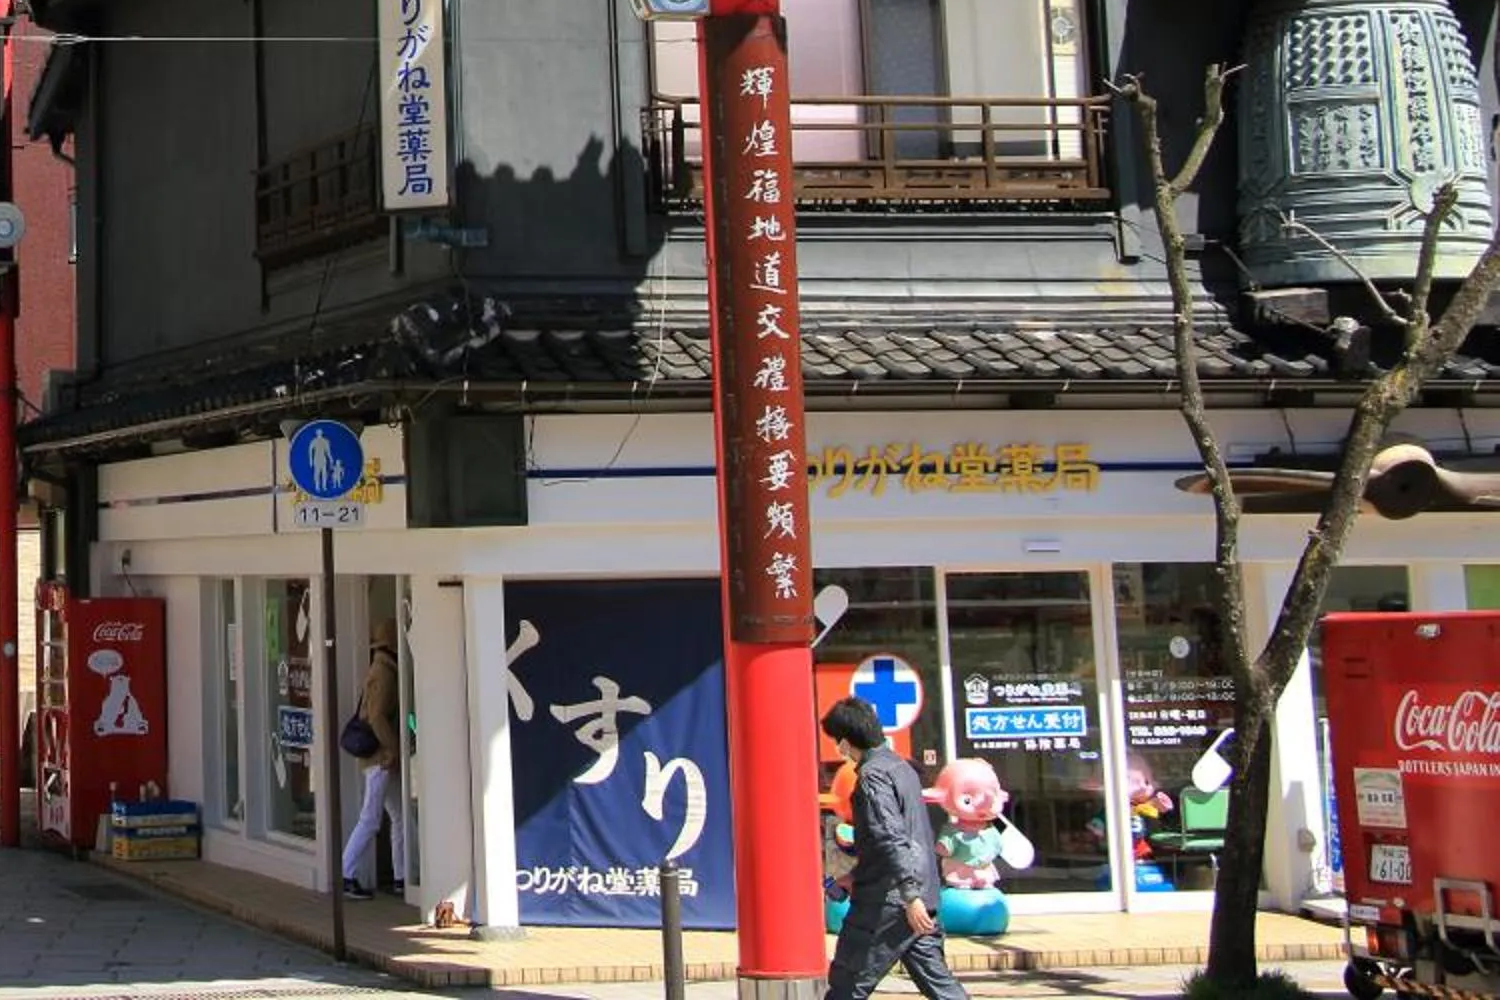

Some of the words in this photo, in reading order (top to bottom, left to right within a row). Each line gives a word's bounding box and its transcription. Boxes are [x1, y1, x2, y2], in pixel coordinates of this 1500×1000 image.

[300, 507, 360, 523] 11-21
[93, 621, 146, 642] Coca-Cola
[971, 711, 1081, 732] 処方せん受付
[1394, 689, 1500, 753] Coca-Cola
[504, 618, 707, 861] くすり
[515, 866, 699, 897] つりがね堂薬局
